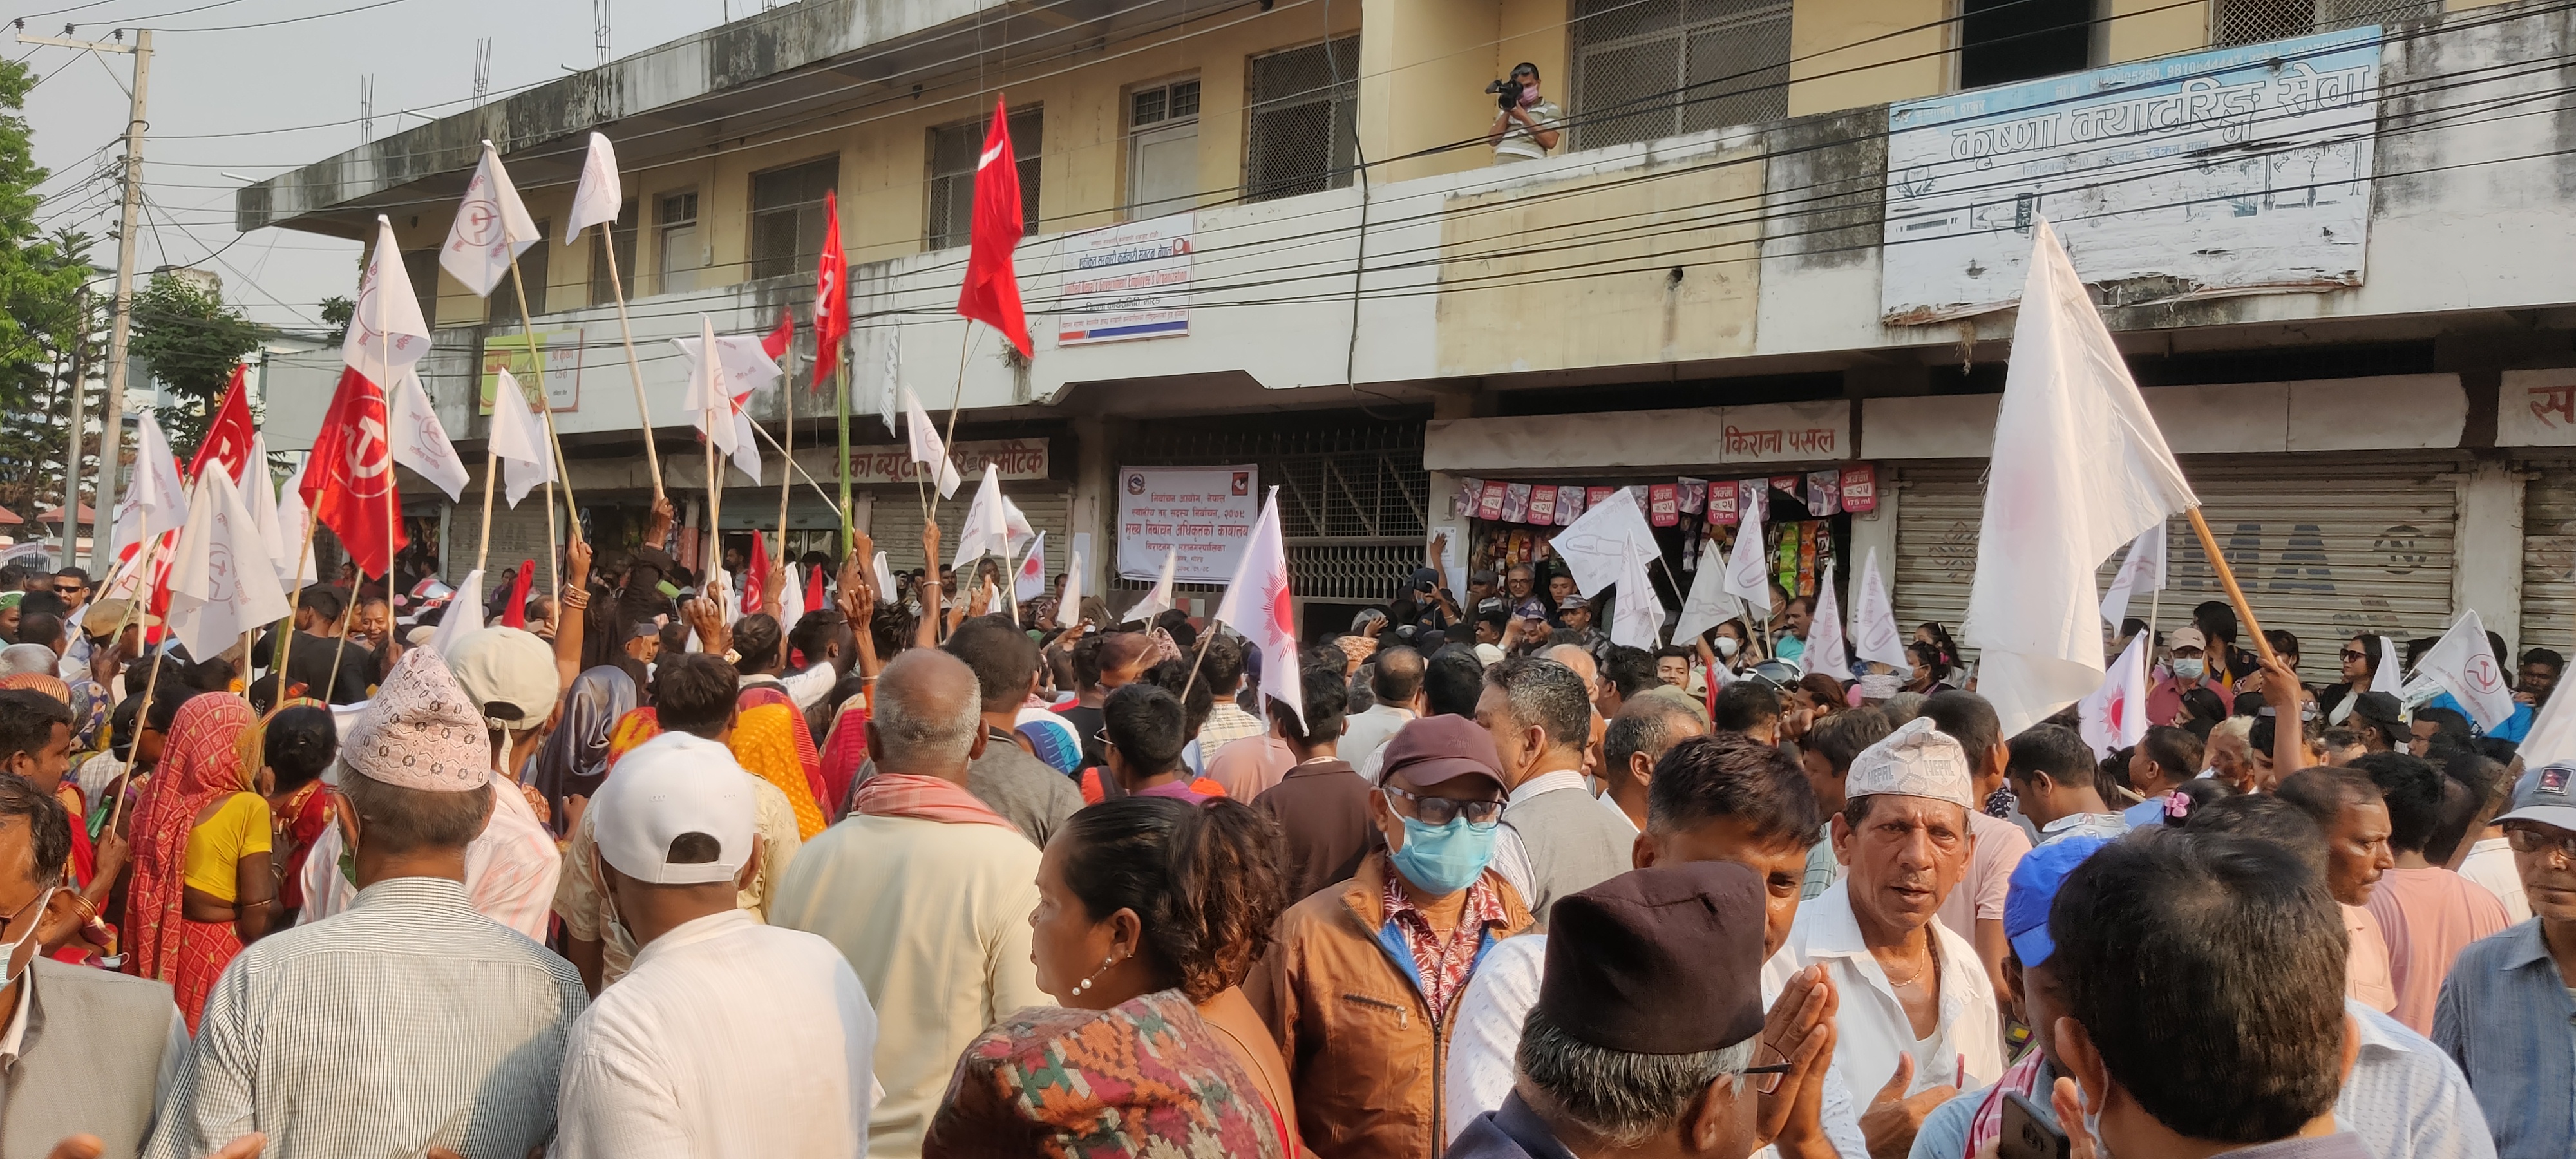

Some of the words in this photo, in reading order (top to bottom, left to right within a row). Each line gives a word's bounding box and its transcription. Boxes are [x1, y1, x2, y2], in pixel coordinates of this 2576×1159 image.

[1951, 111, 2062, 171] कृष्णा
[2277, 62, 2371, 118] सेवा
[1724, 424, 1783, 458] किराना
[1788, 428, 1835, 455] पसल
[1151, 492, 1176, 503] निर्वाचन
[1207, 493, 1226, 504] नेपाल
[1125, 523, 1142, 540] मुख्य
[1146, 519, 1172, 536] निर्वाचन
[1175, 520, 1215, 542] अधिकृतको
[1218, 520, 1249, 539] कार्यालय
[1868, 764, 1894, 787] NEPAL
[1922, 760, 1955, 777] NEPAL
